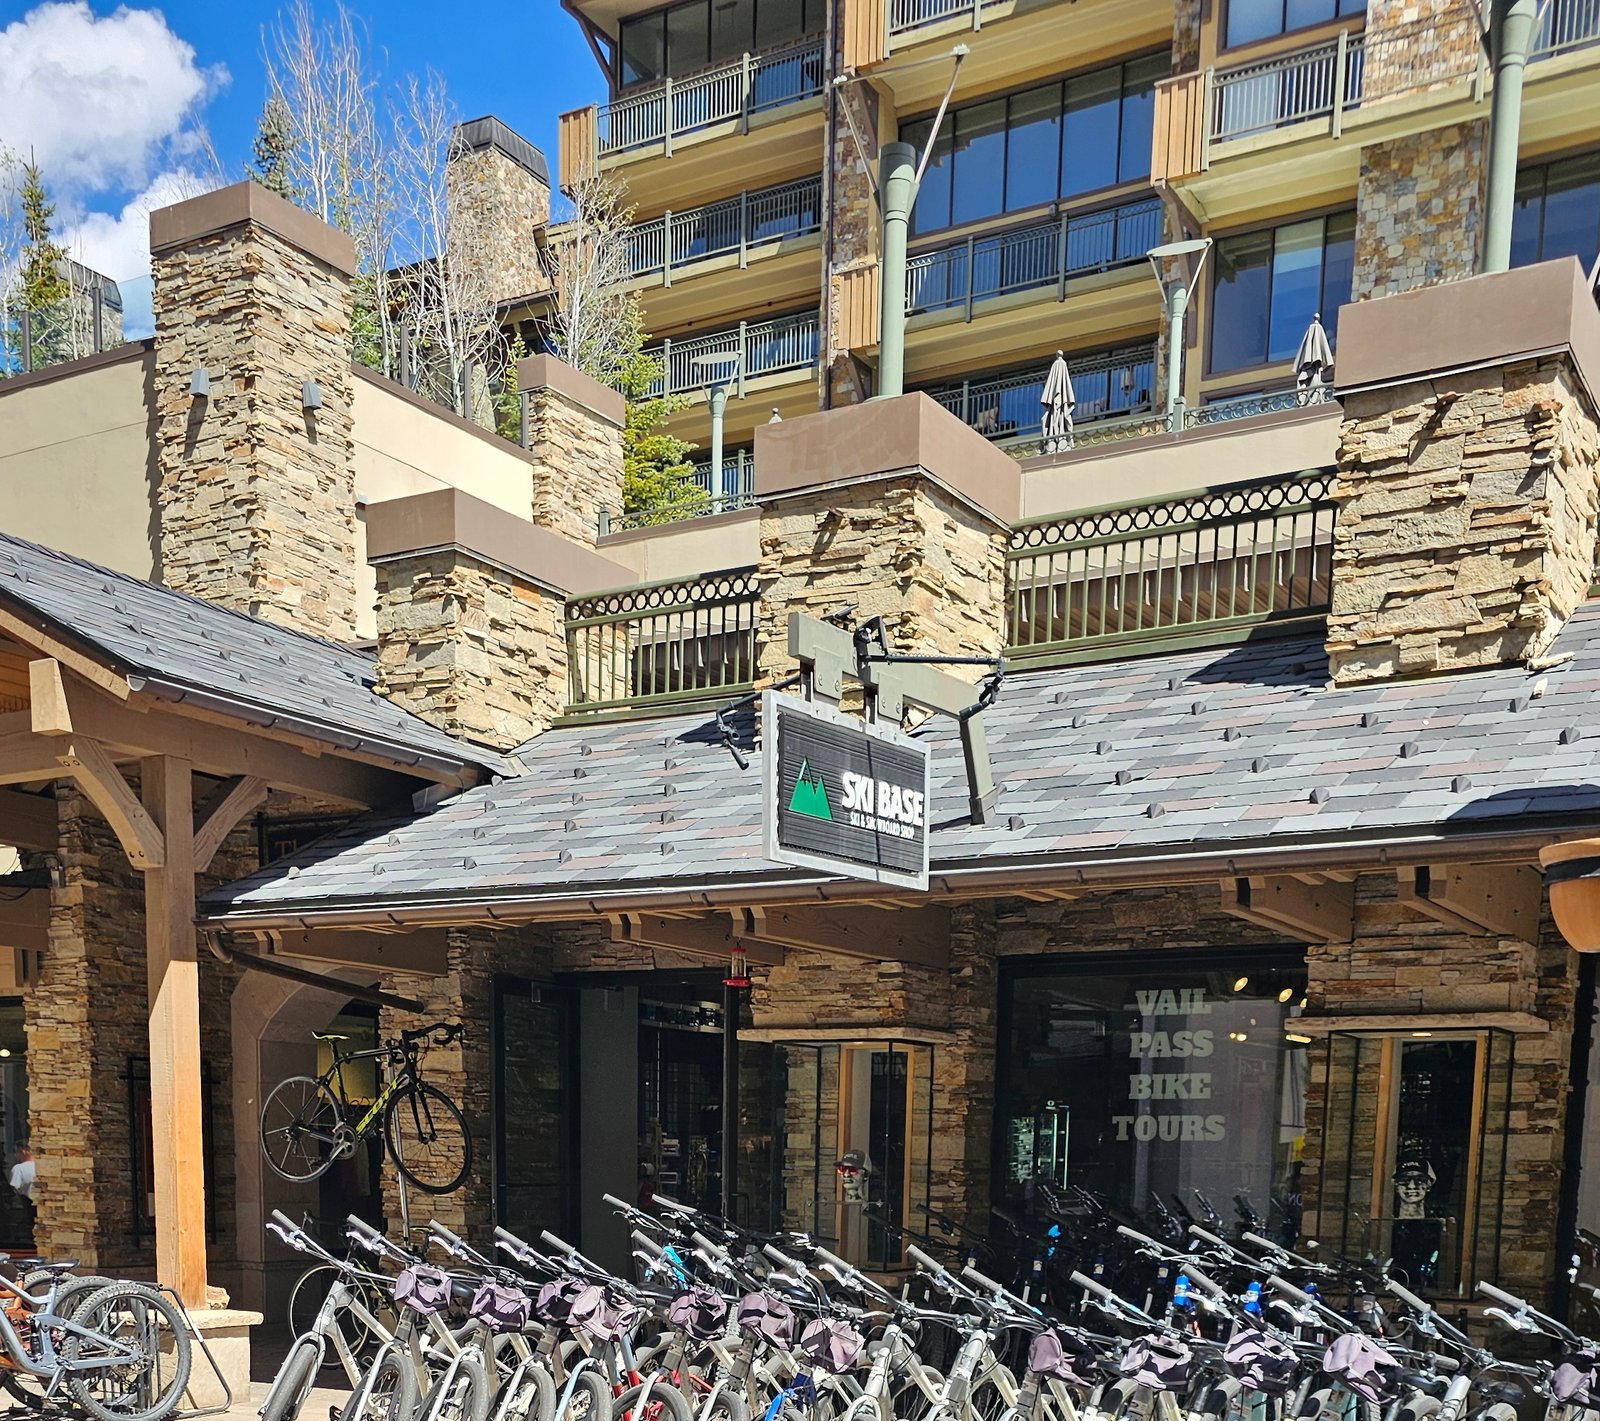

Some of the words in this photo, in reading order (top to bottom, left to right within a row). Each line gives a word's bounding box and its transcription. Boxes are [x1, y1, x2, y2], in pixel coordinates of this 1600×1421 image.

[841, 771, 875, 814] SKI
[878, 780, 925, 827] BASE
[850, 811, 860, 826] SKI
[1135, 988, 1212, 1017] VAIL
[1129, 1029, 1215, 1059] PASS
[1128, 1072, 1212, 1100] BIKE
[356, 1077, 398, 1132] SCOTT
[1112, 1115, 1226, 1142] TOURS
